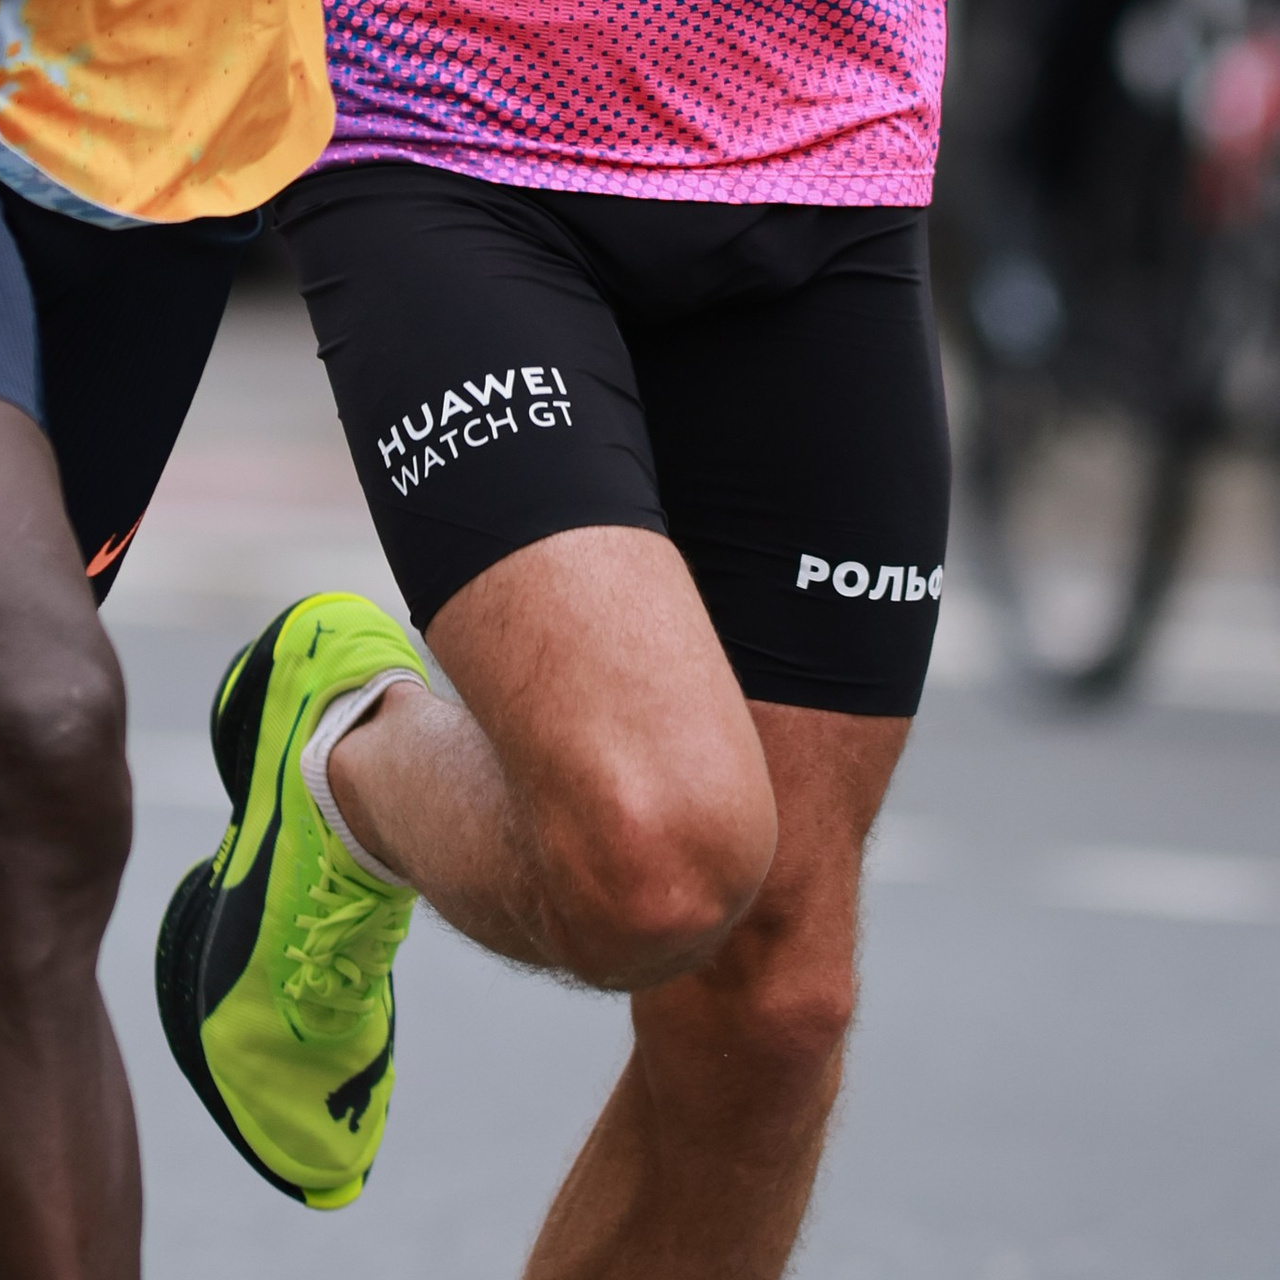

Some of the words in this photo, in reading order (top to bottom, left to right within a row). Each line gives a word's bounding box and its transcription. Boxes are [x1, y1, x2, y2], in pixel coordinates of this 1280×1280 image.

[377, 366, 568, 469] HUAWEI
[391, 407, 519, 497] WATCH
[528, 400, 573, 428] GT
